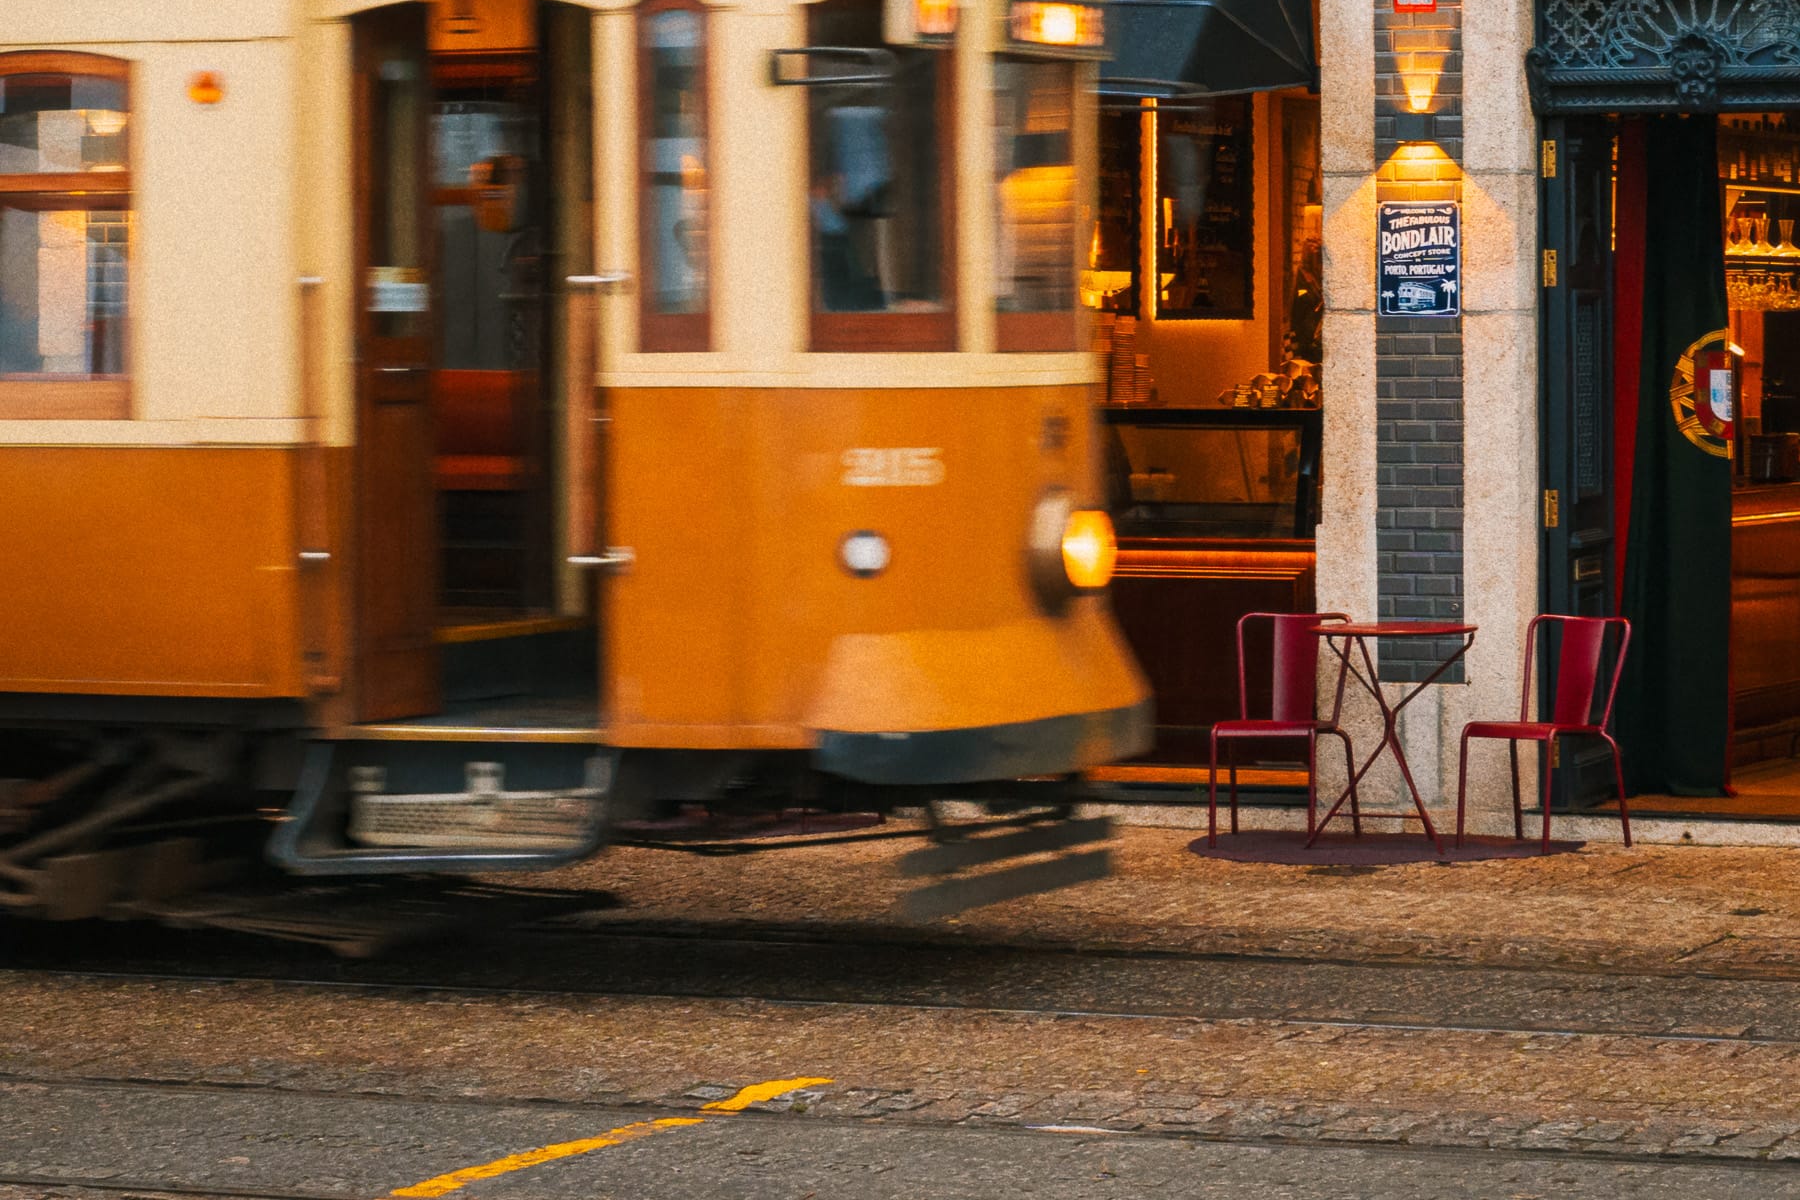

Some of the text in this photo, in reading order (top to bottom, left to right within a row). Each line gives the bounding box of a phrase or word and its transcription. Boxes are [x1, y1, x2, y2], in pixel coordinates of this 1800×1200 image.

[1381, 226, 1456, 255] BONDLAIR
[1393, 248, 1451, 260] CONCEPT STORE
[1409, 263, 1446, 276] PORTUGAL
